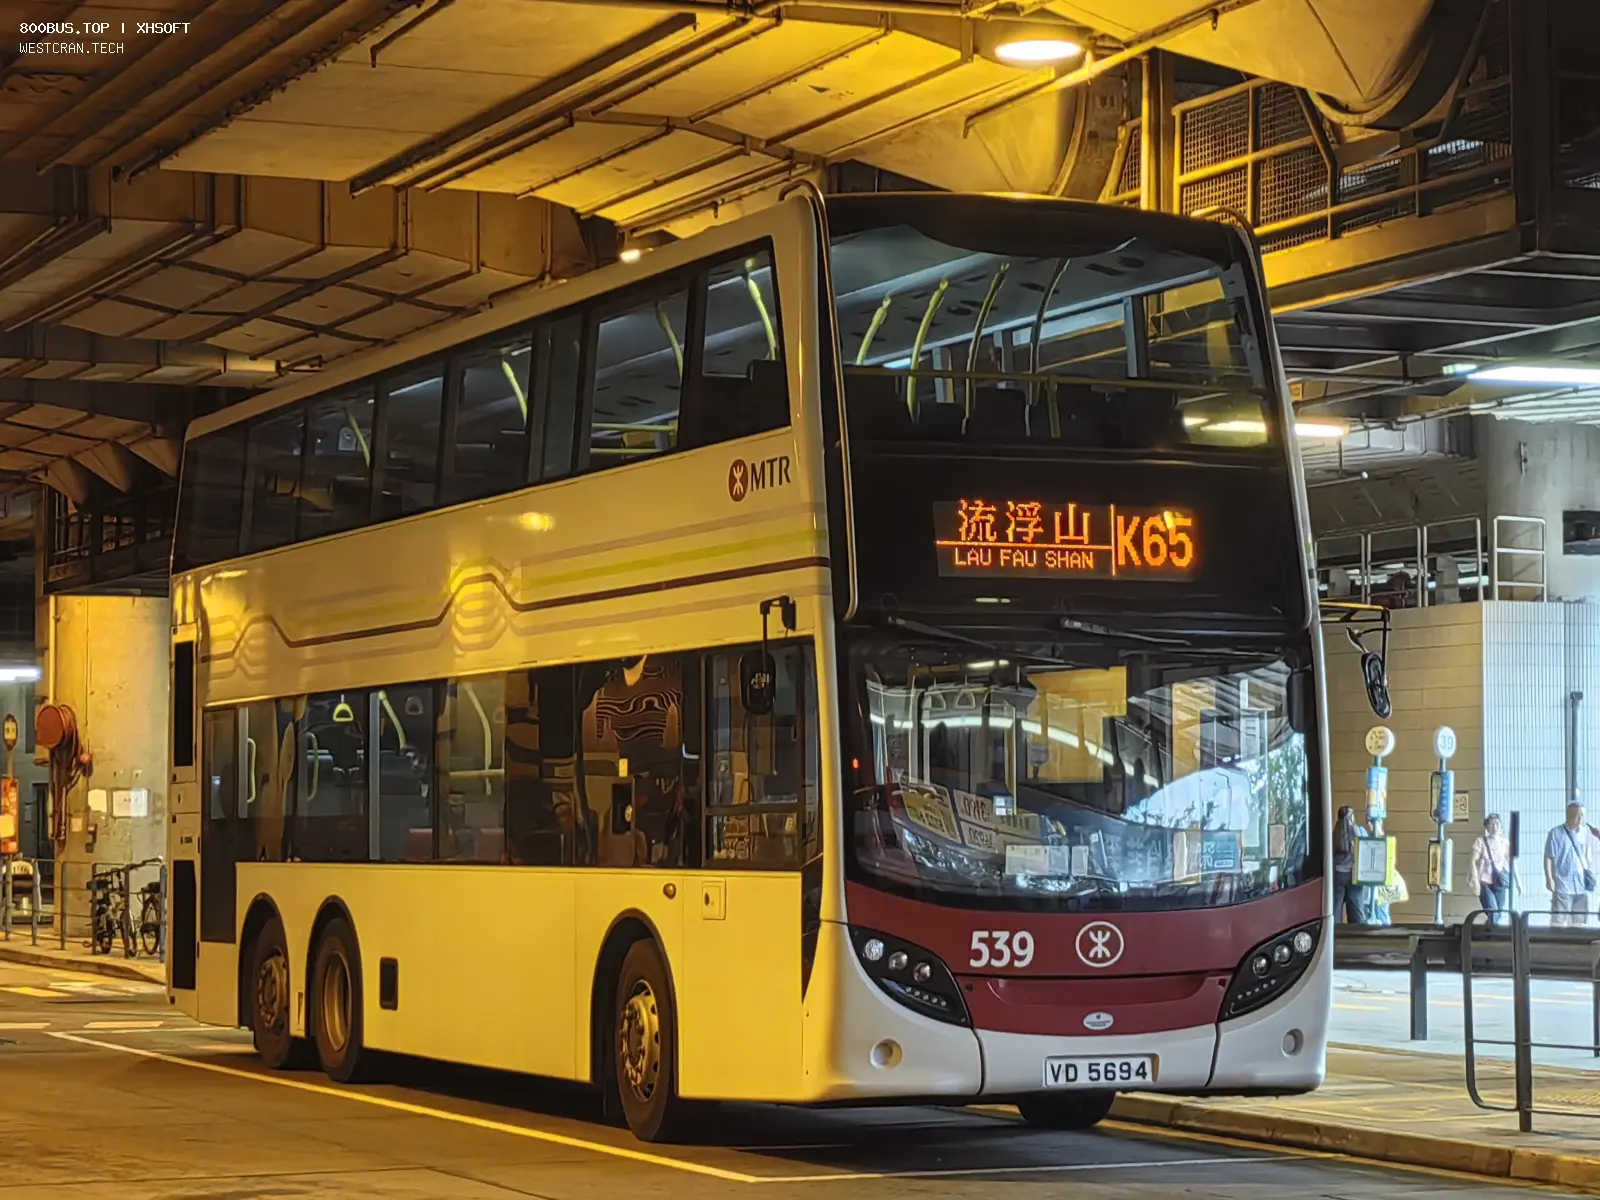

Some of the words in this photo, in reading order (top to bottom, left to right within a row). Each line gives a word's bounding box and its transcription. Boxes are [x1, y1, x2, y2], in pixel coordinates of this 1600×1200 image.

[750, 455, 791, 492] MTR
[958, 499, 1090, 545] 流浮山
[1116, 510, 1194, 568] K65
[954, 547, 992, 566] LAU
[999, 548, 1037, 568] FAU
[1044, 550, 1094, 570] SHAN
[969, 930, 1035, 968] 539
[1050, 1063, 1078, 1083] VD
[1087, 1061, 1148, 1082] 5694
